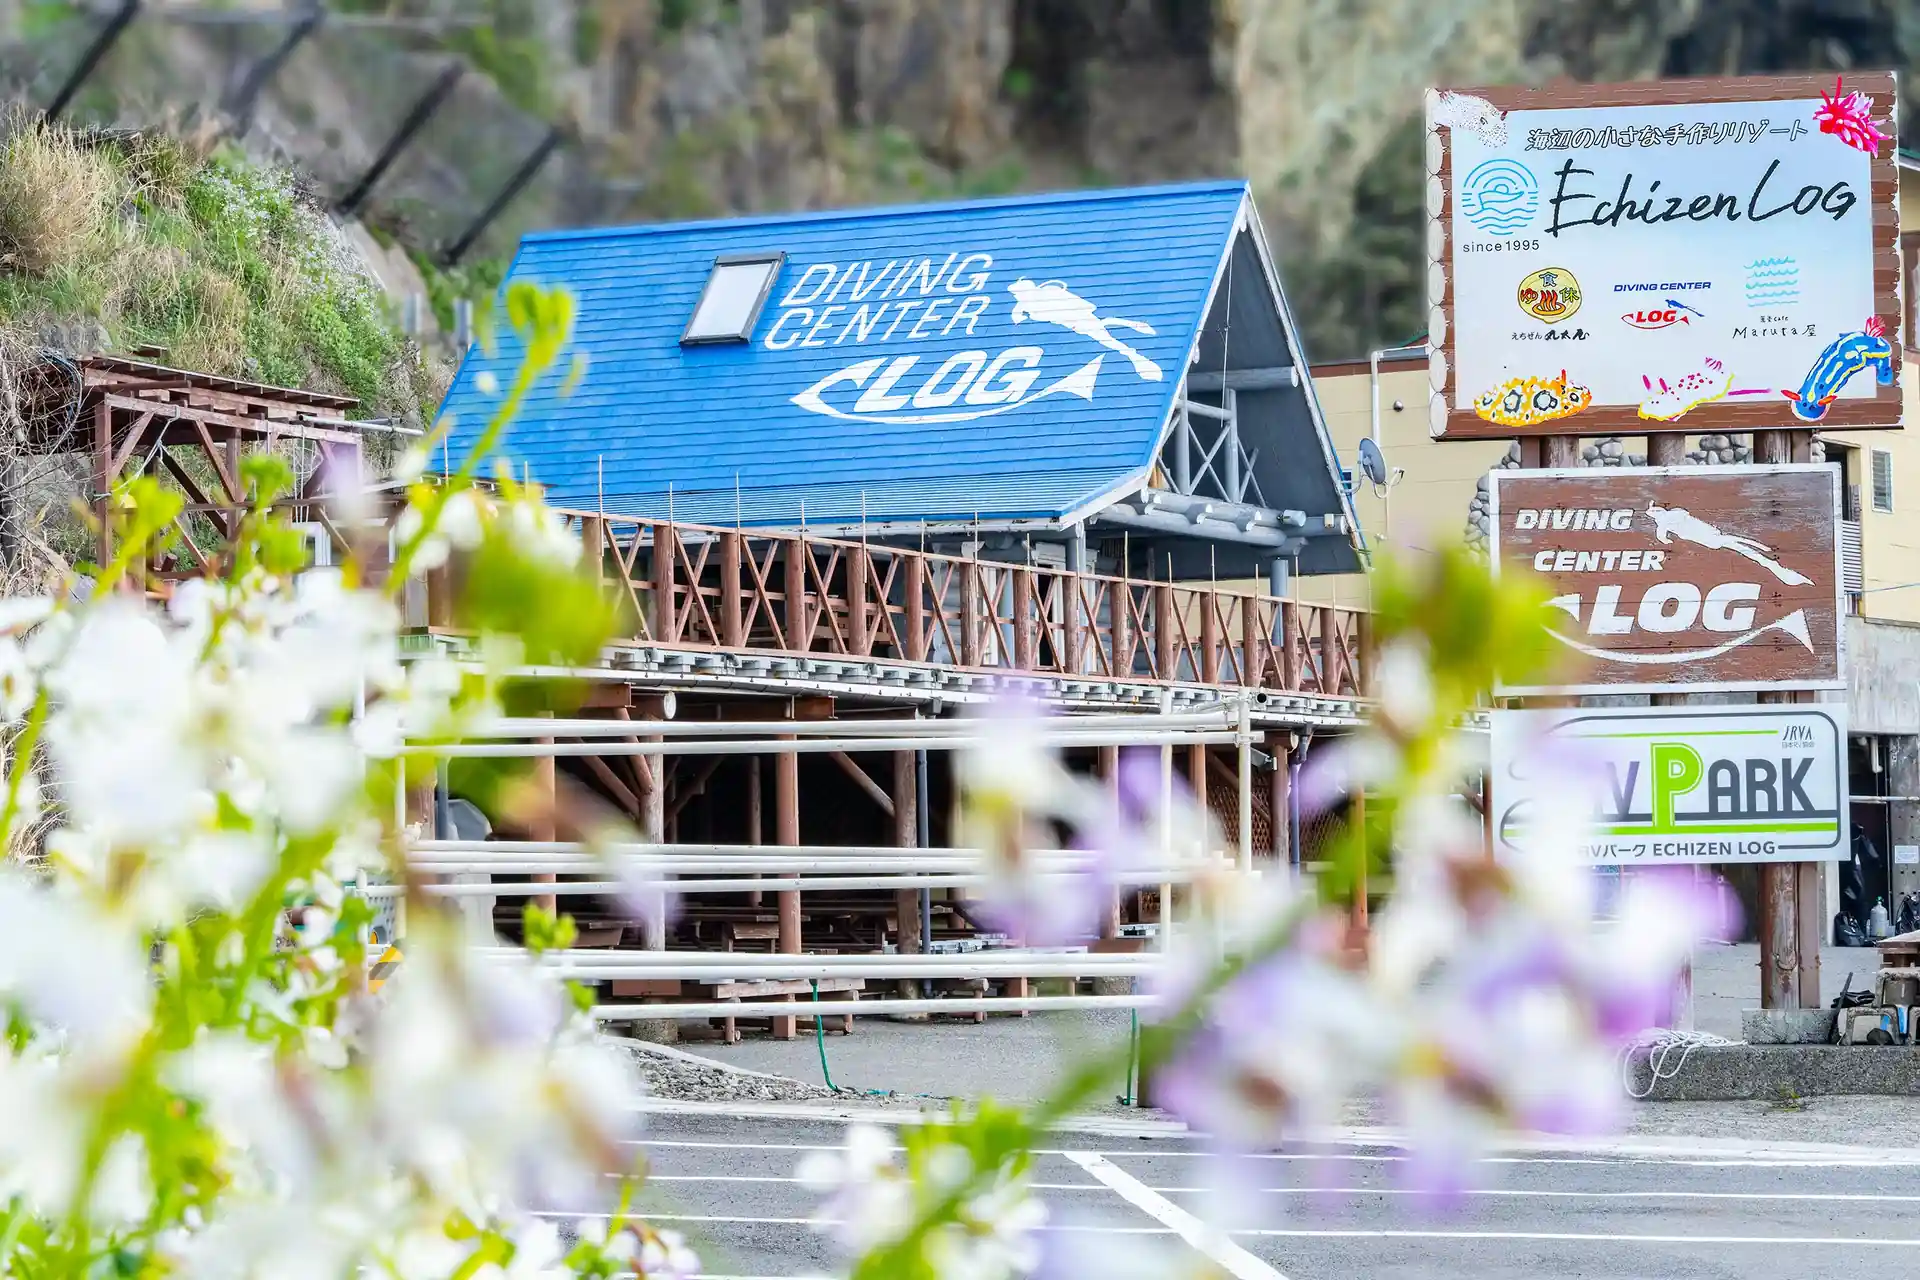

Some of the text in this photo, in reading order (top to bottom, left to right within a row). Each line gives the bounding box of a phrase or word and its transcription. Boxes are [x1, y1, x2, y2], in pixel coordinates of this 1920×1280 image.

[1525, 119, 1808, 151] 海辺の小さな手作りリゾート
[1544, 158, 1742, 238] Echizen
[779, 252, 994, 308] DIVING
[1613, 281, 1712, 292] DIVING CENTER
[764, 295, 992, 350] CENTER
[1635, 309, 1677, 323] LOG
[1515, 508, 1635, 531] DIVING
[1533, 550, 1666, 572] CENTER
[1587, 581, 1762, 635] LOG
[1650, 742, 1816, 827] PARK
[1653, 842, 1732, 856] ECHIZEN
[1738, 841, 1775, 855] LOG
